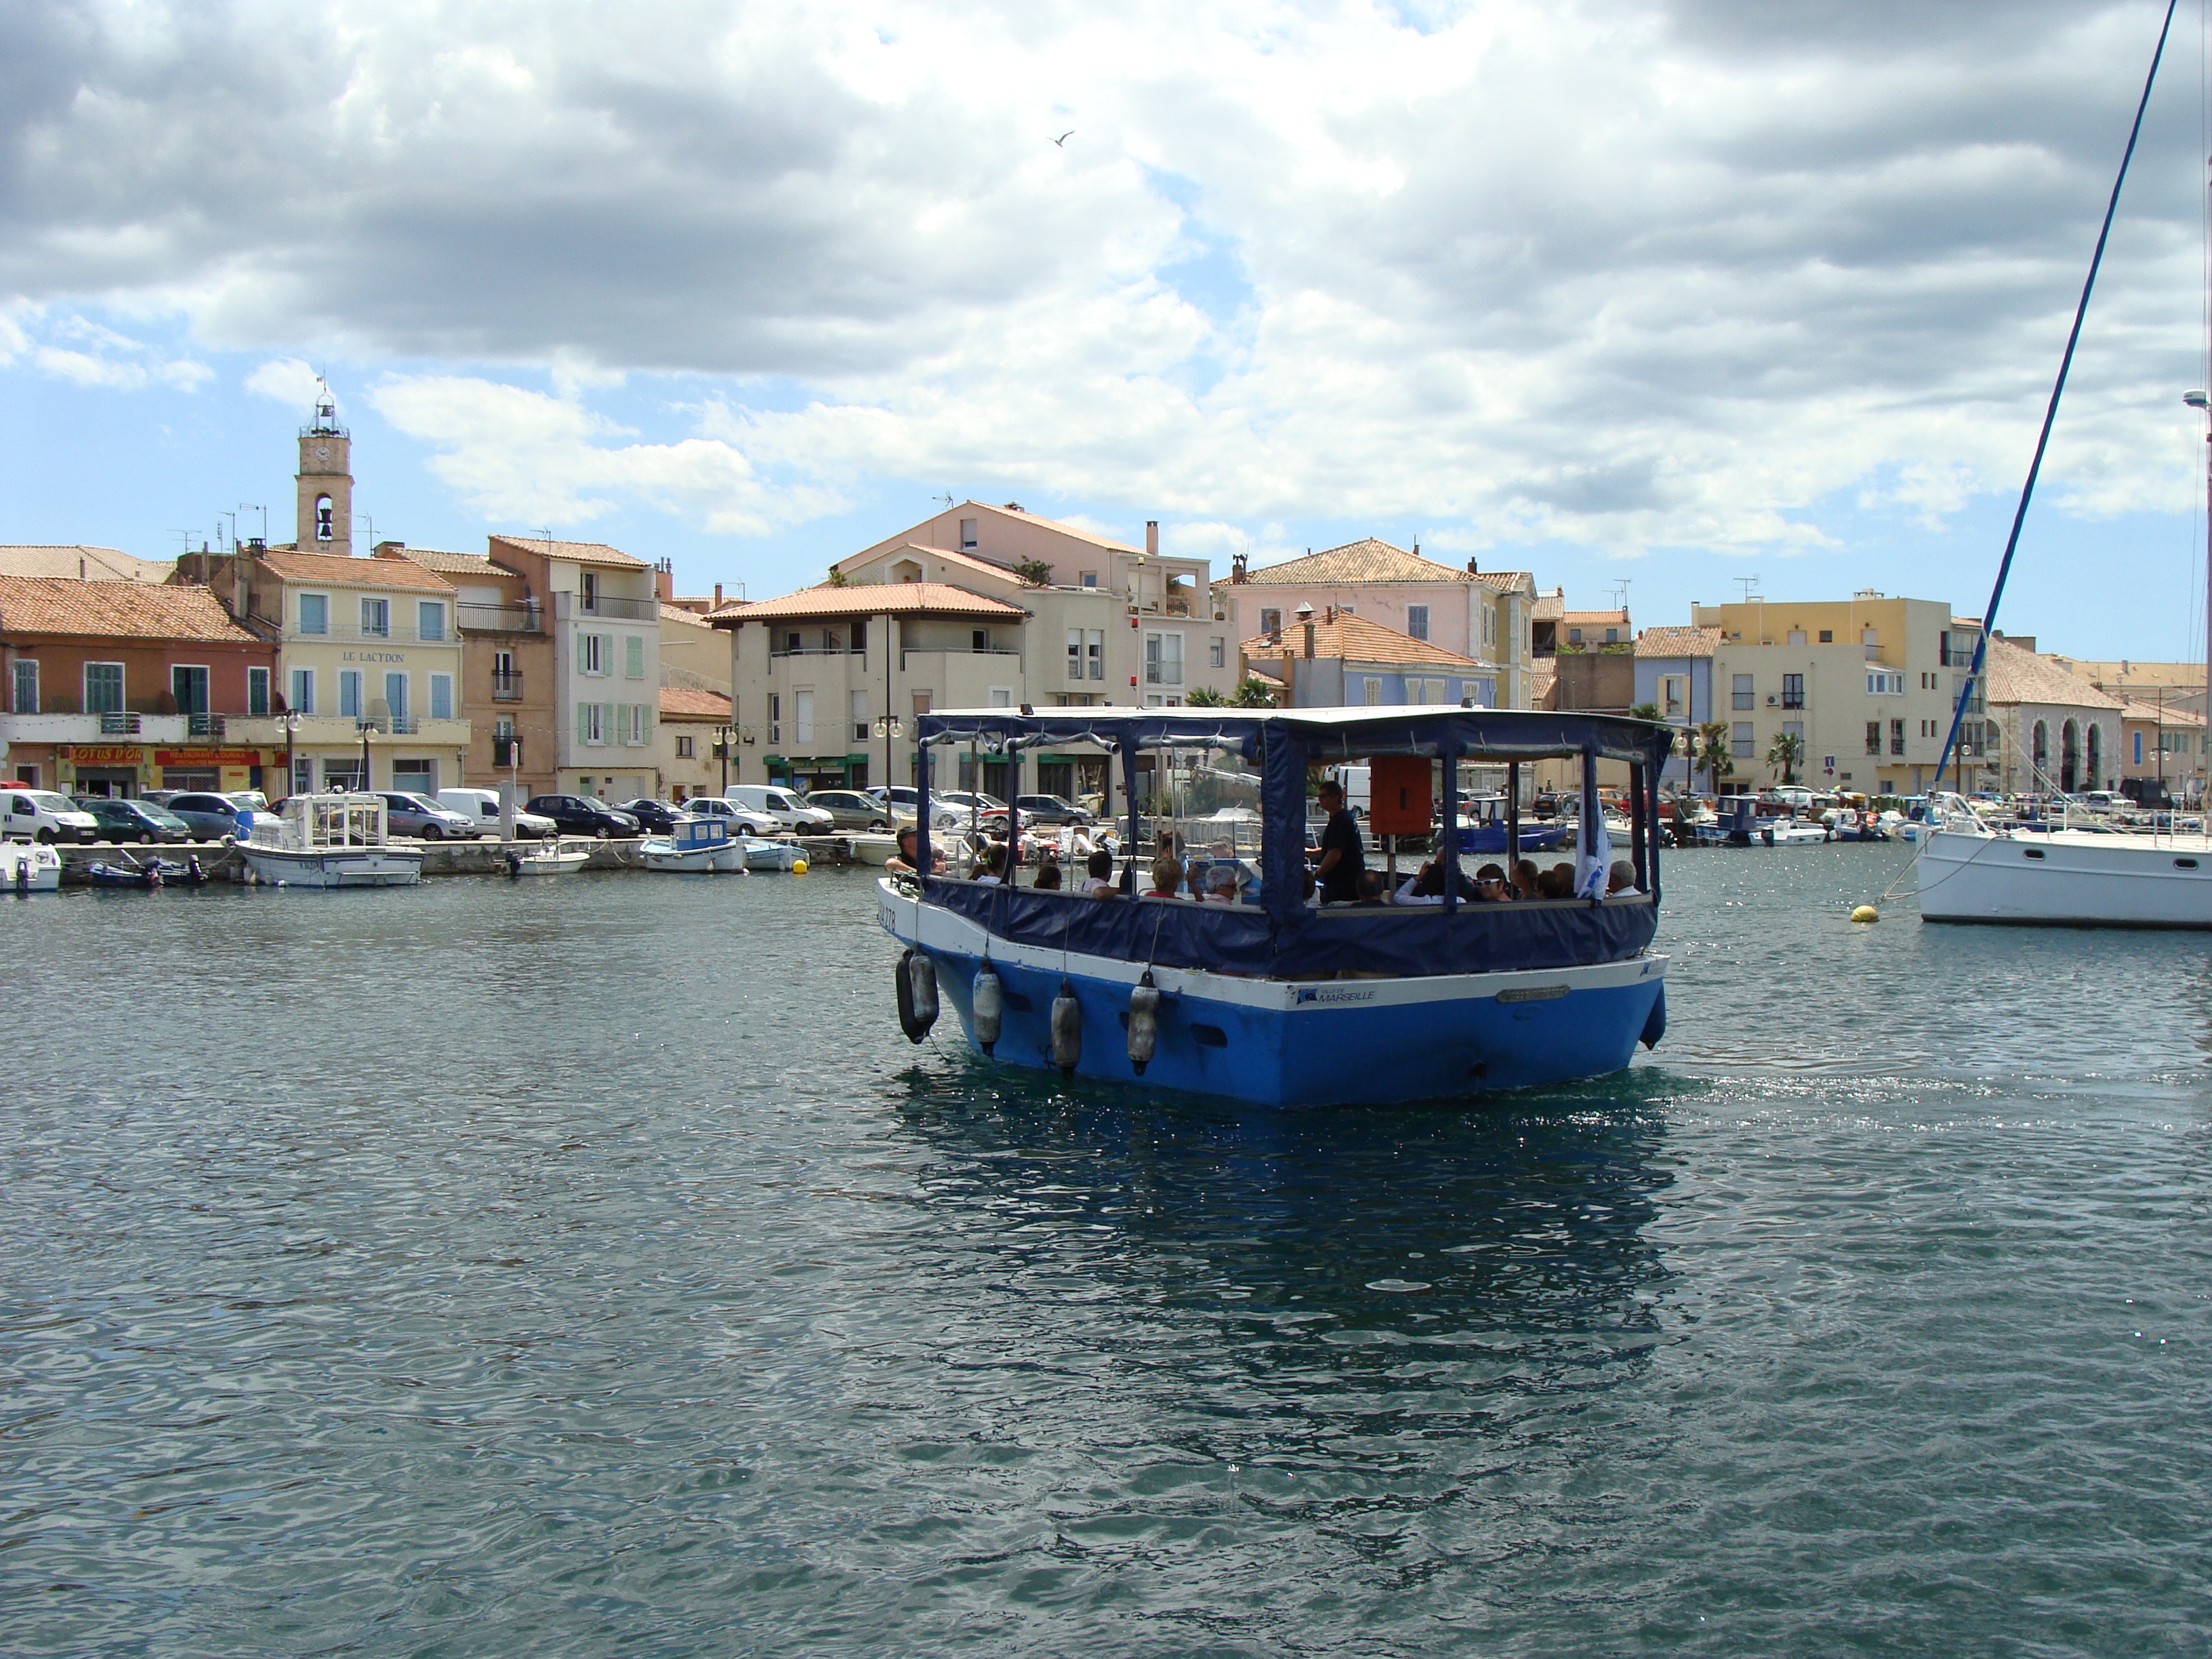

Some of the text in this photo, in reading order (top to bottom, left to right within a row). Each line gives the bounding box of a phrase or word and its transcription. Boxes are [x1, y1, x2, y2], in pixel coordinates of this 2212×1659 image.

[343, 652, 404, 663] LE LACYDON
[72, 748, 143, 759] LOTUS D'OR
[1319, 991, 1375, 1002] MARSEILLE
